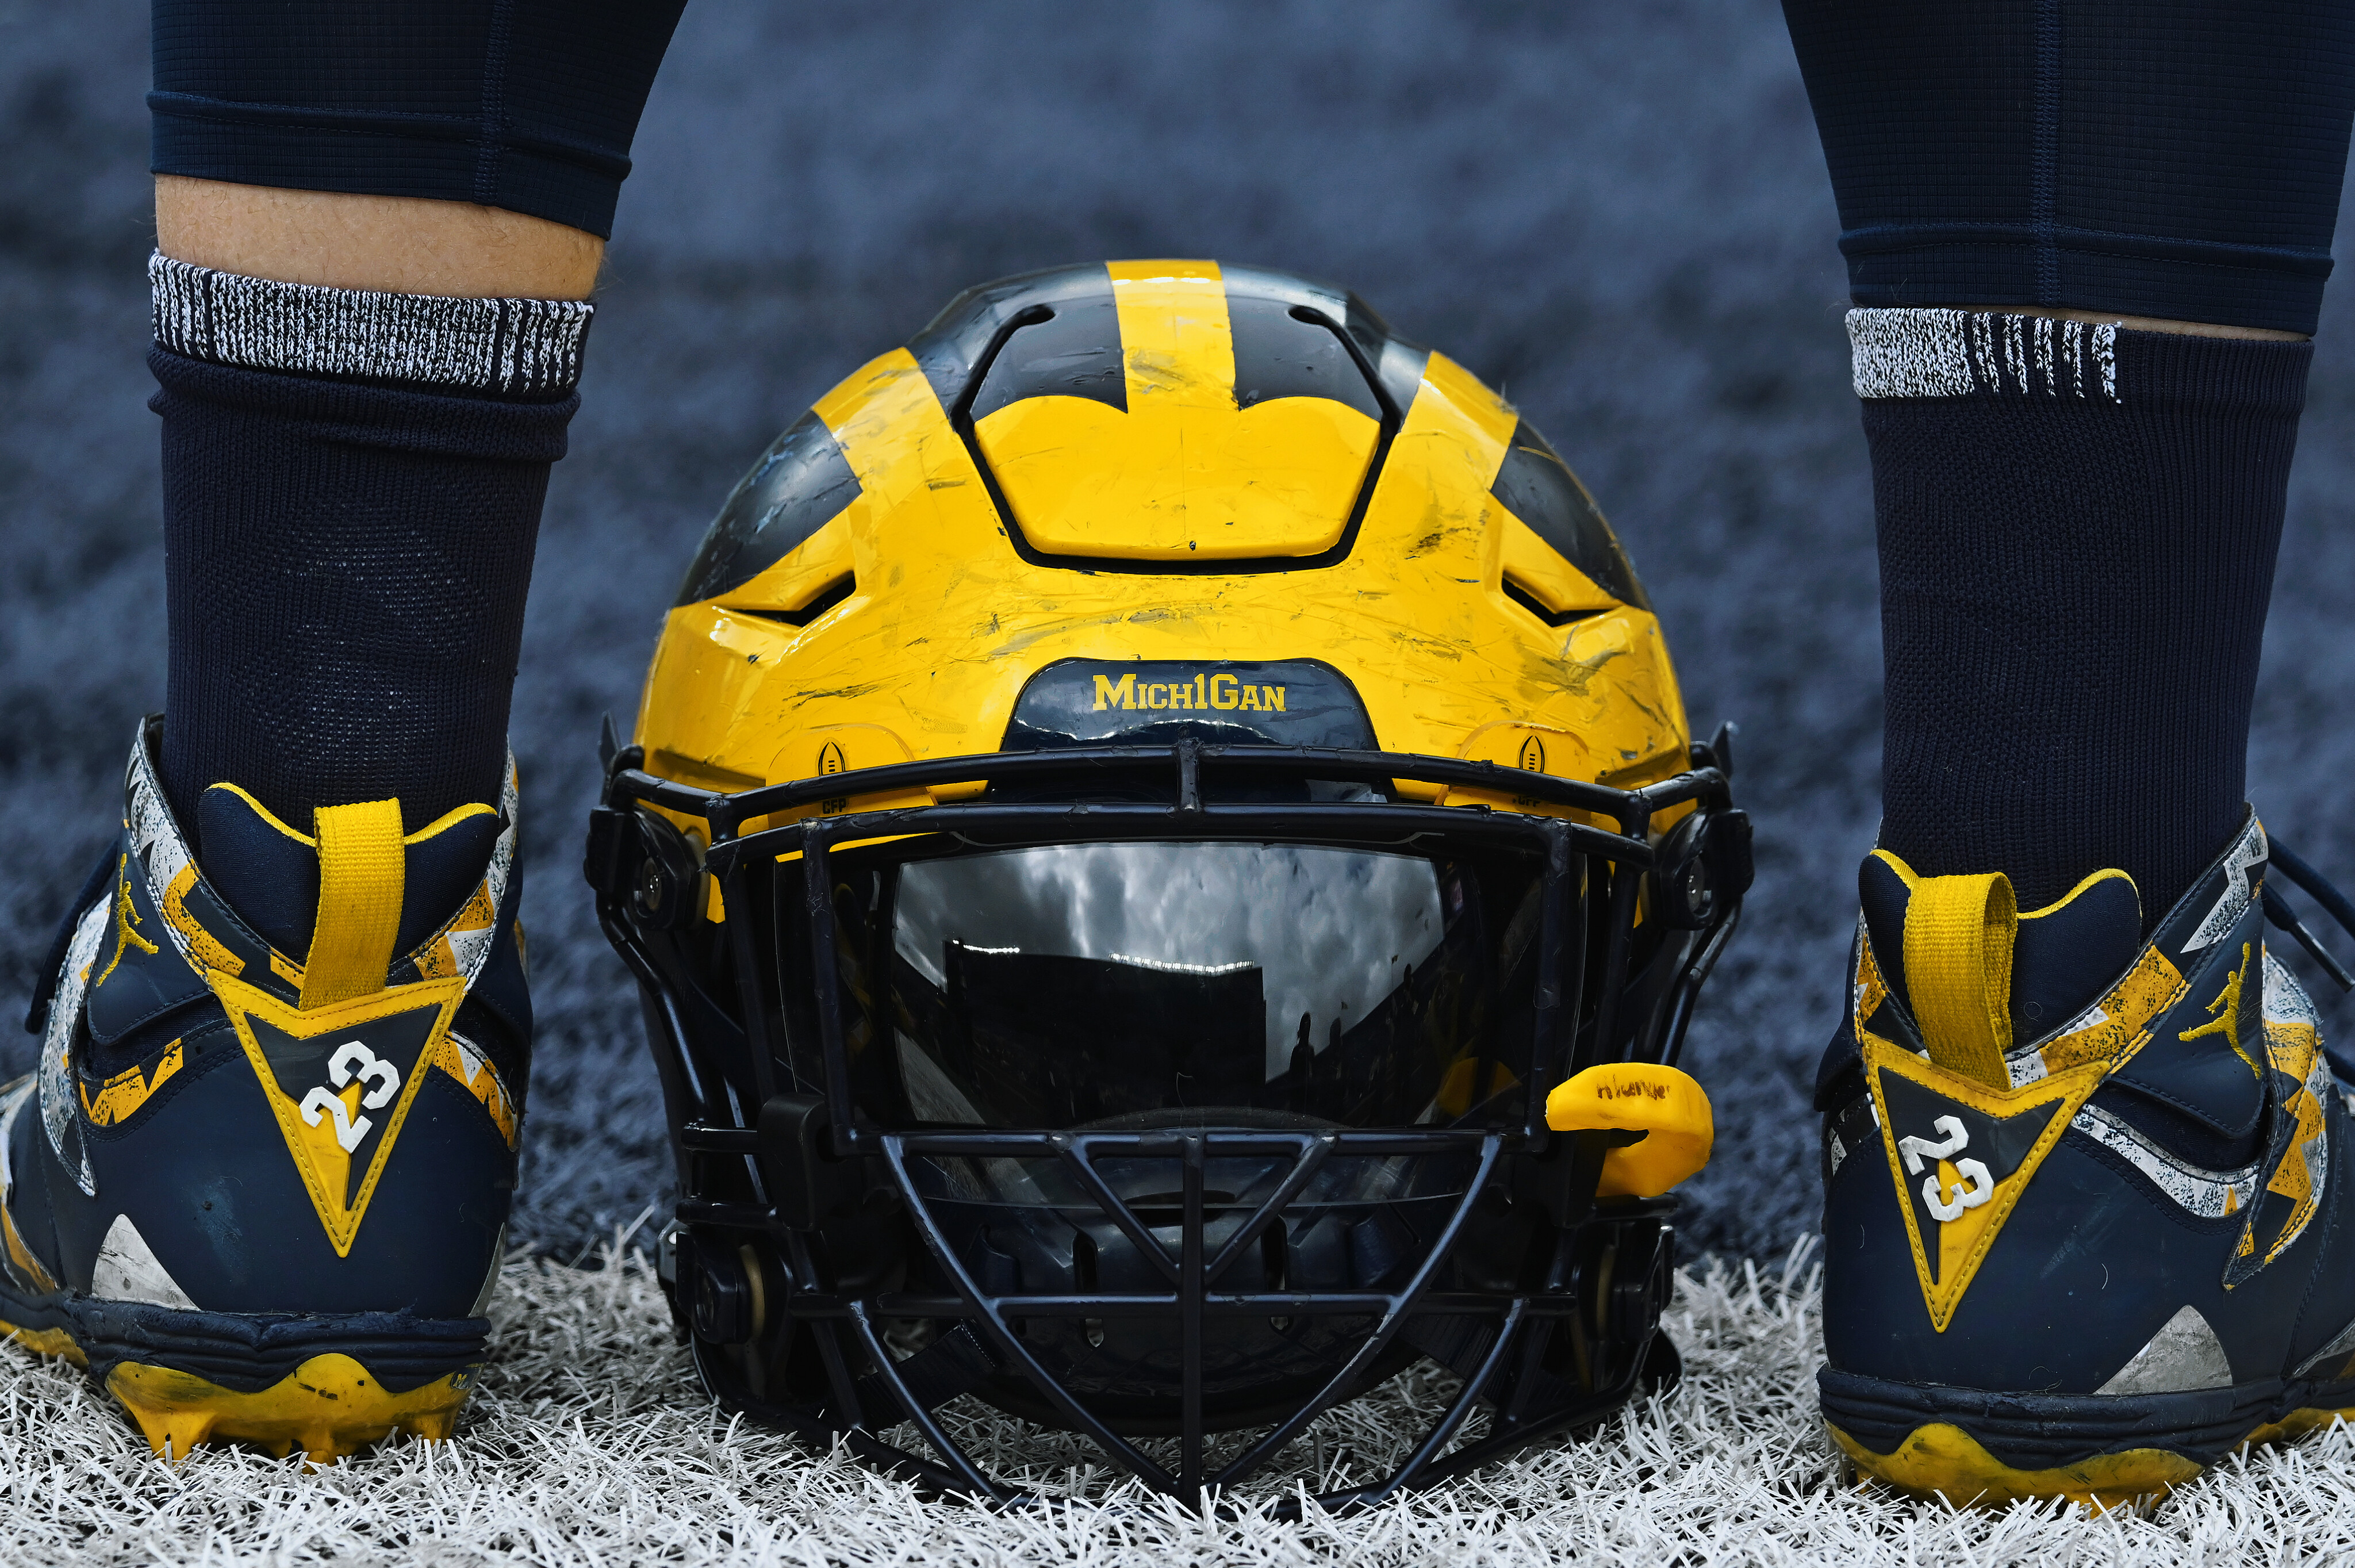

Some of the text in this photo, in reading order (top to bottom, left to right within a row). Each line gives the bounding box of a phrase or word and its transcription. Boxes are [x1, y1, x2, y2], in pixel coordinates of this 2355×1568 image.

[822, 798, 846, 814] CFP
[299, 1040, 401, 1154] 23
[1898, 1115, 1995, 1222] 23
